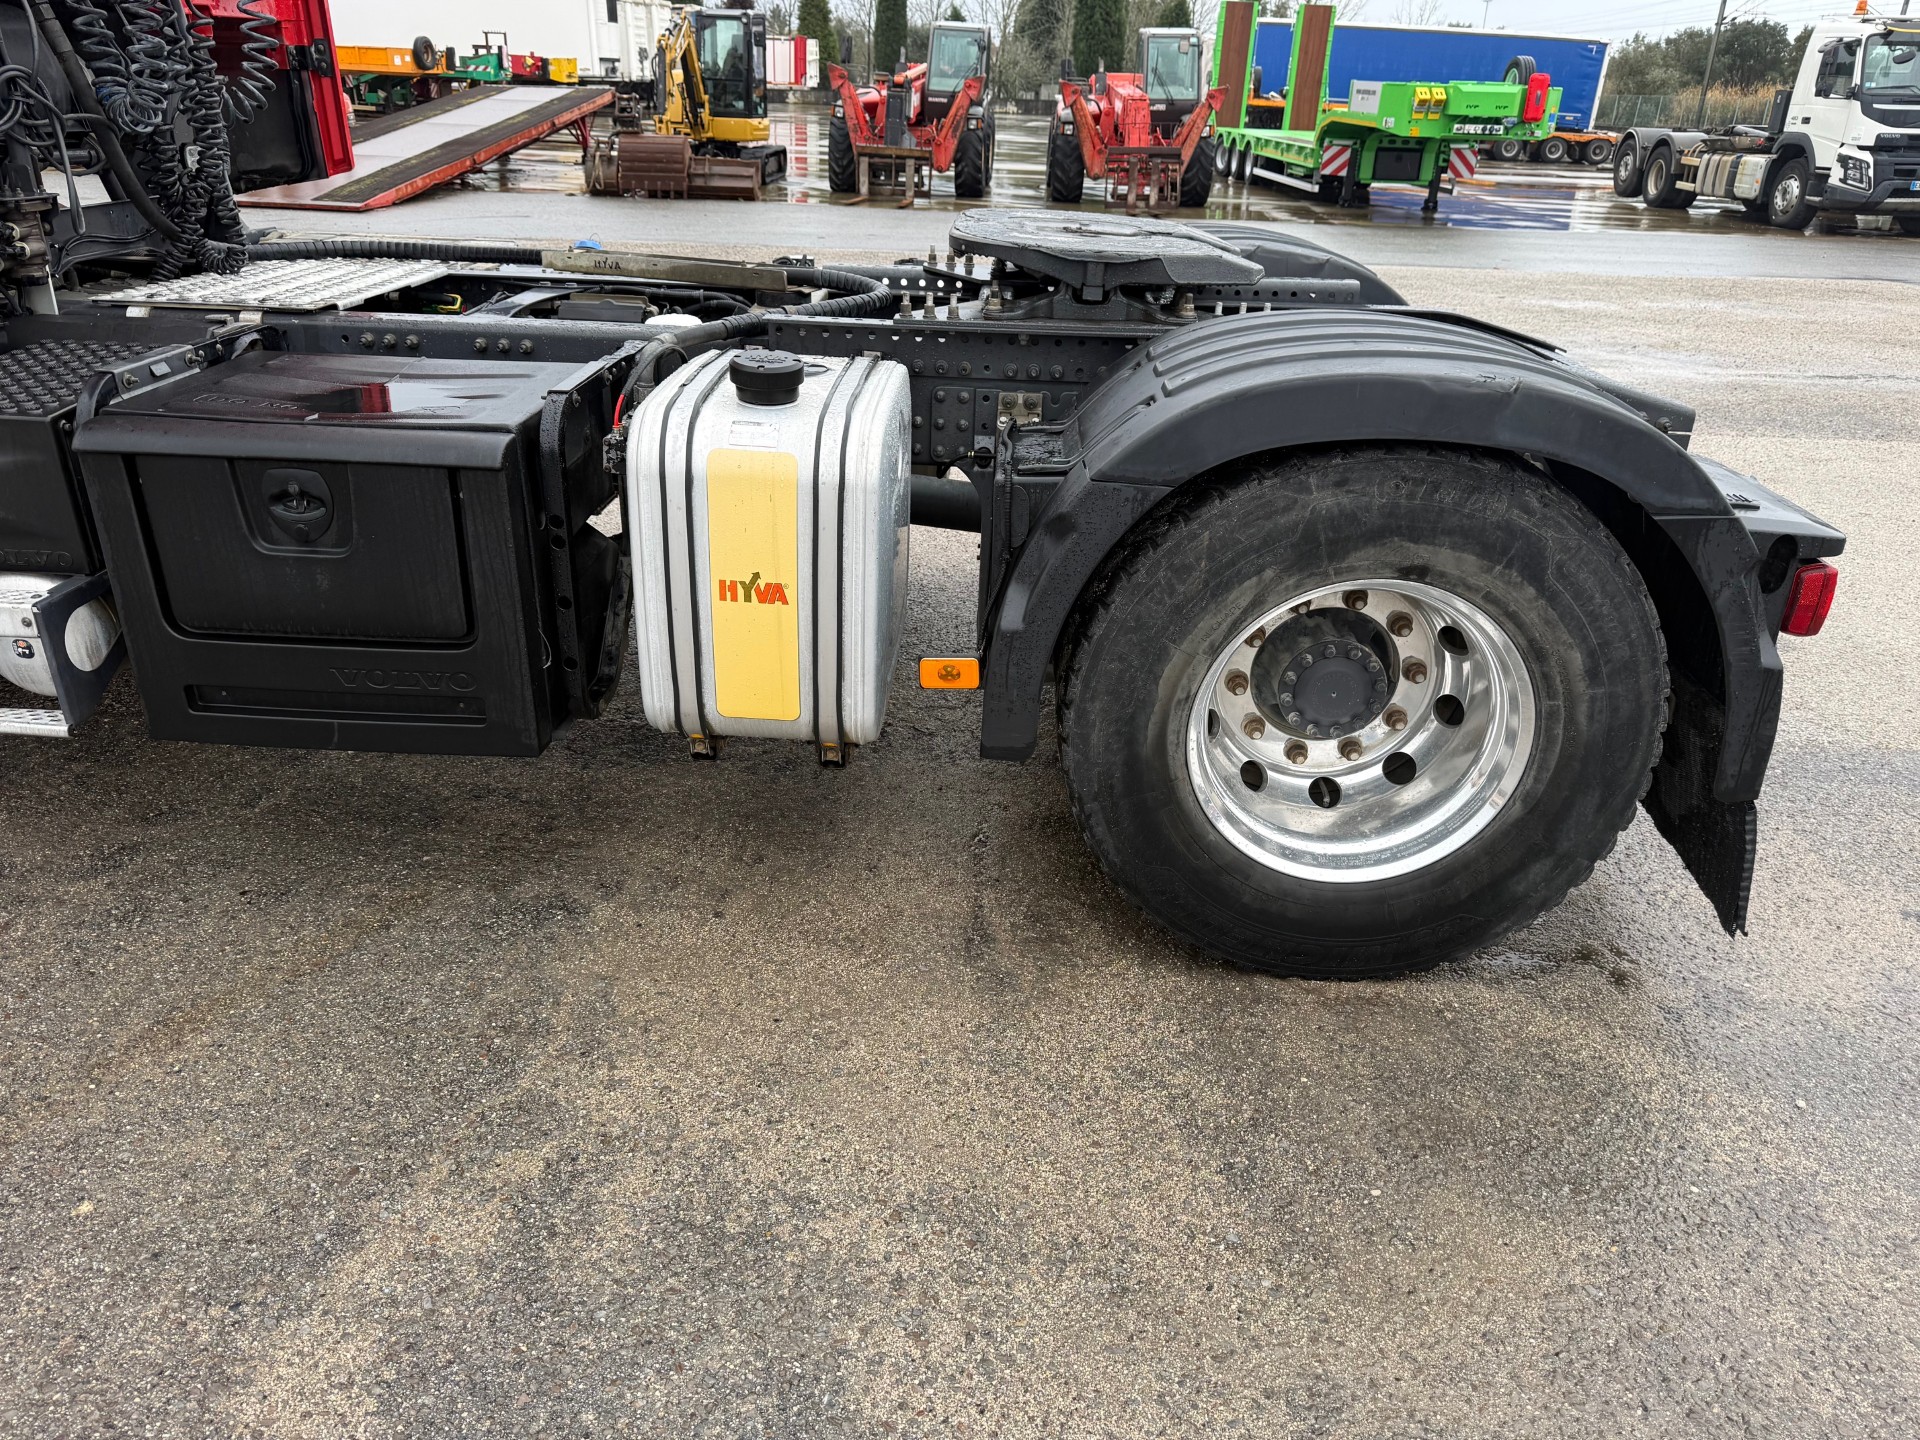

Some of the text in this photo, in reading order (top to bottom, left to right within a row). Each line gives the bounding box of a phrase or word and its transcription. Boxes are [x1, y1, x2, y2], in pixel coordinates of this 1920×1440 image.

[594, 257, 622, 270] HYVA
[718, 571, 789, 605] HYVA
[327, 667, 478, 692] VOLVO
